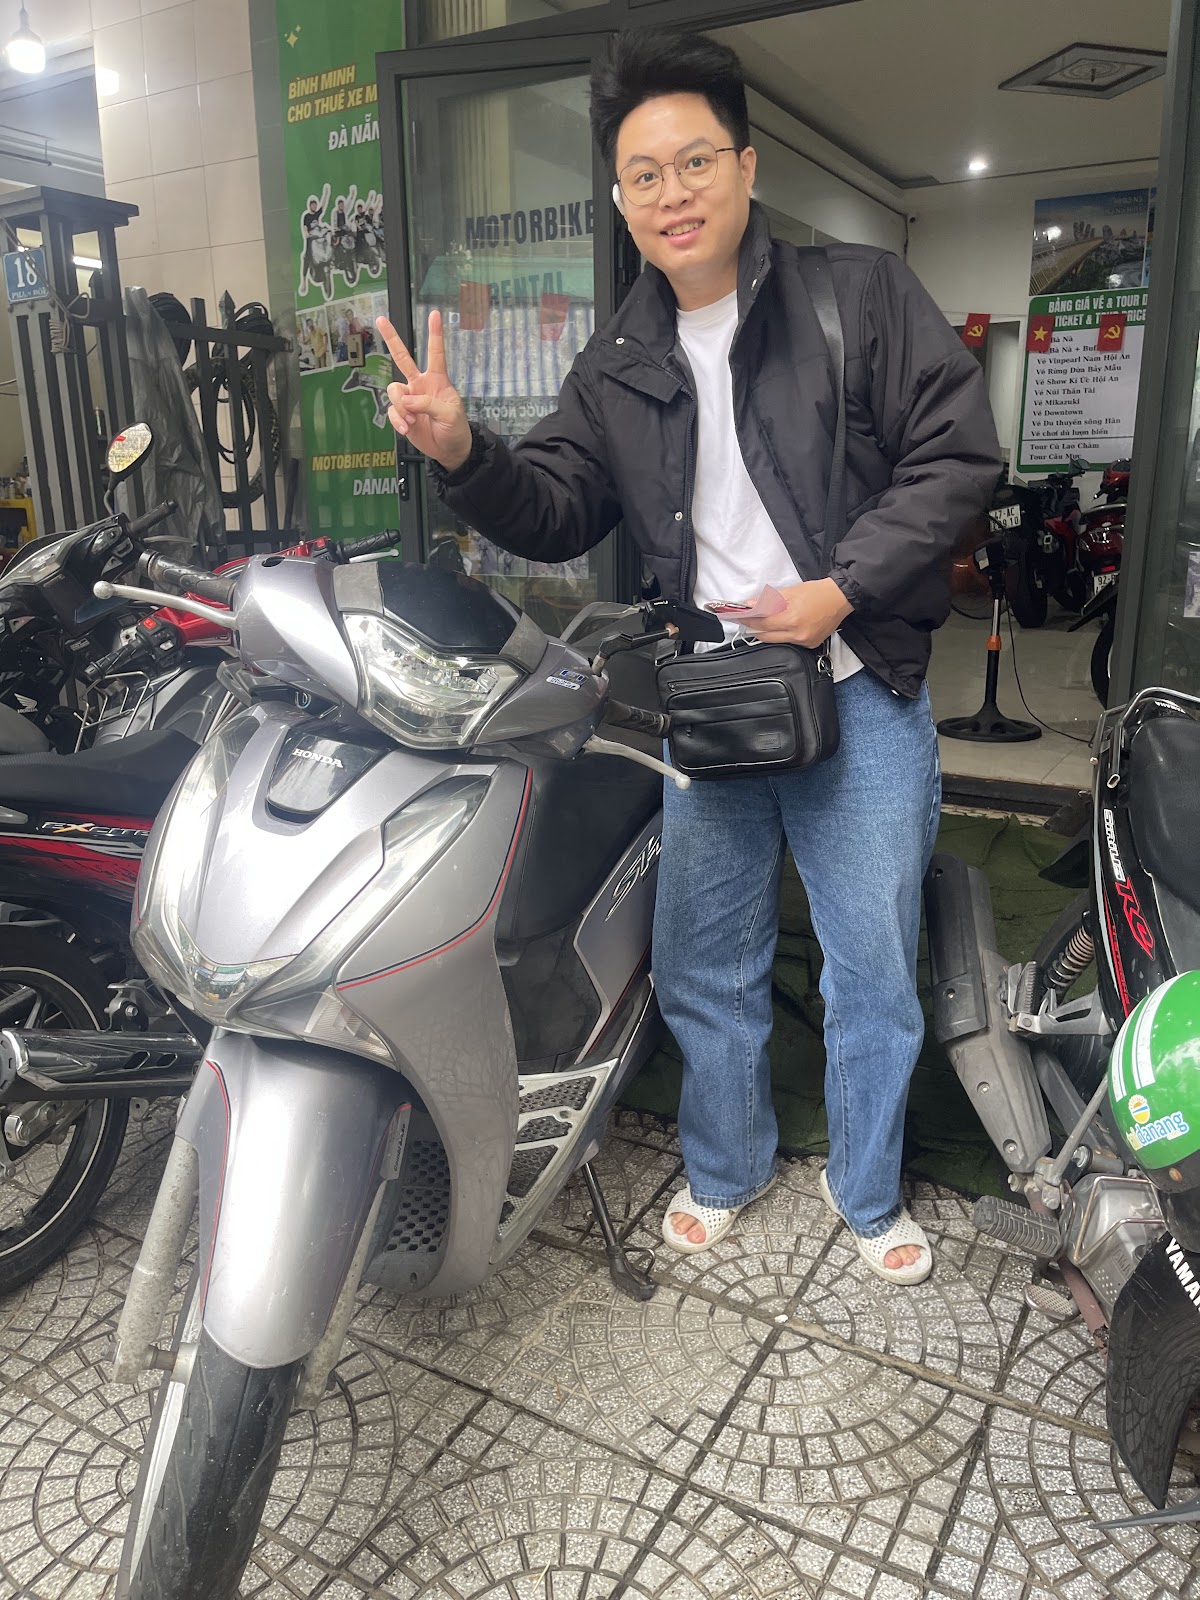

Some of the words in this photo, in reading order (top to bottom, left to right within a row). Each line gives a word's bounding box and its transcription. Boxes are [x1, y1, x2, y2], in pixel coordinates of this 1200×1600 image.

[288, 76, 319, 100] BÌNH
[320, 65, 356, 91] MINH
[287, 101, 312, 123] CHO
[314, 88, 346, 116] THUÊ
[347, 87, 364, 108] XE
[328, 124, 348, 151] ĐÀ
[1048, 297, 1073, 314] BẢNG
[1075, 295, 1090, 311] GIÁ
[1093, 294, 1104, 309] VÉ
[1106, 297, 1113, 309] &
[1116, 295, 1140, 308] TOUR
[1054, 313, 1084, 328] TICKET
[1086, 313, 1092, 325] &
[1049, 356, 1081, 365] Vinpearl
[1045, 398, 1080, 406] Mikazuki
[312, 452, 371, 471] MOTOBIKE
[353, 477, 399, 496] DANAN
[292, 748, 344, 769] HONDA
[1103, 808, 1126, 882] SIRIUS
[1165, 1236, 1200, 1314] YAMA
